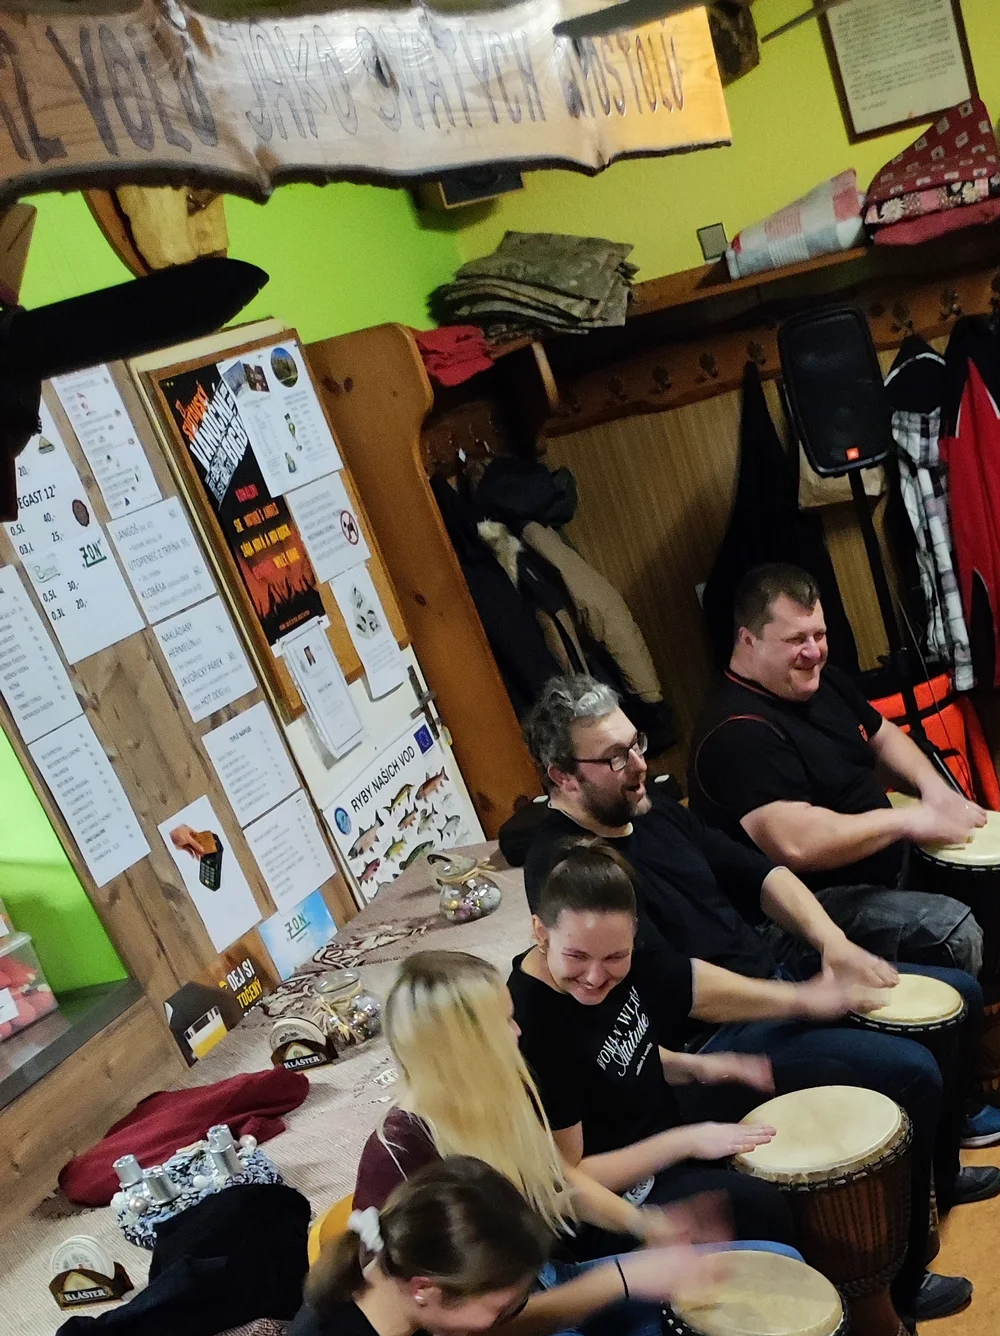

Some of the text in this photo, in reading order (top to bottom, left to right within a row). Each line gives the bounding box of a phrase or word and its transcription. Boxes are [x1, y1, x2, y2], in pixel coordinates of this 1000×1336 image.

[17, 489, 43, 510] EGAST
[350, 745, 415, 813] RYBY NAŠICH VOD
[226, 958, 256, 992] DEJ SI
[236, 978, 264, 1010] TOČENÝ
[617, 985, 642, 1026] WITH
